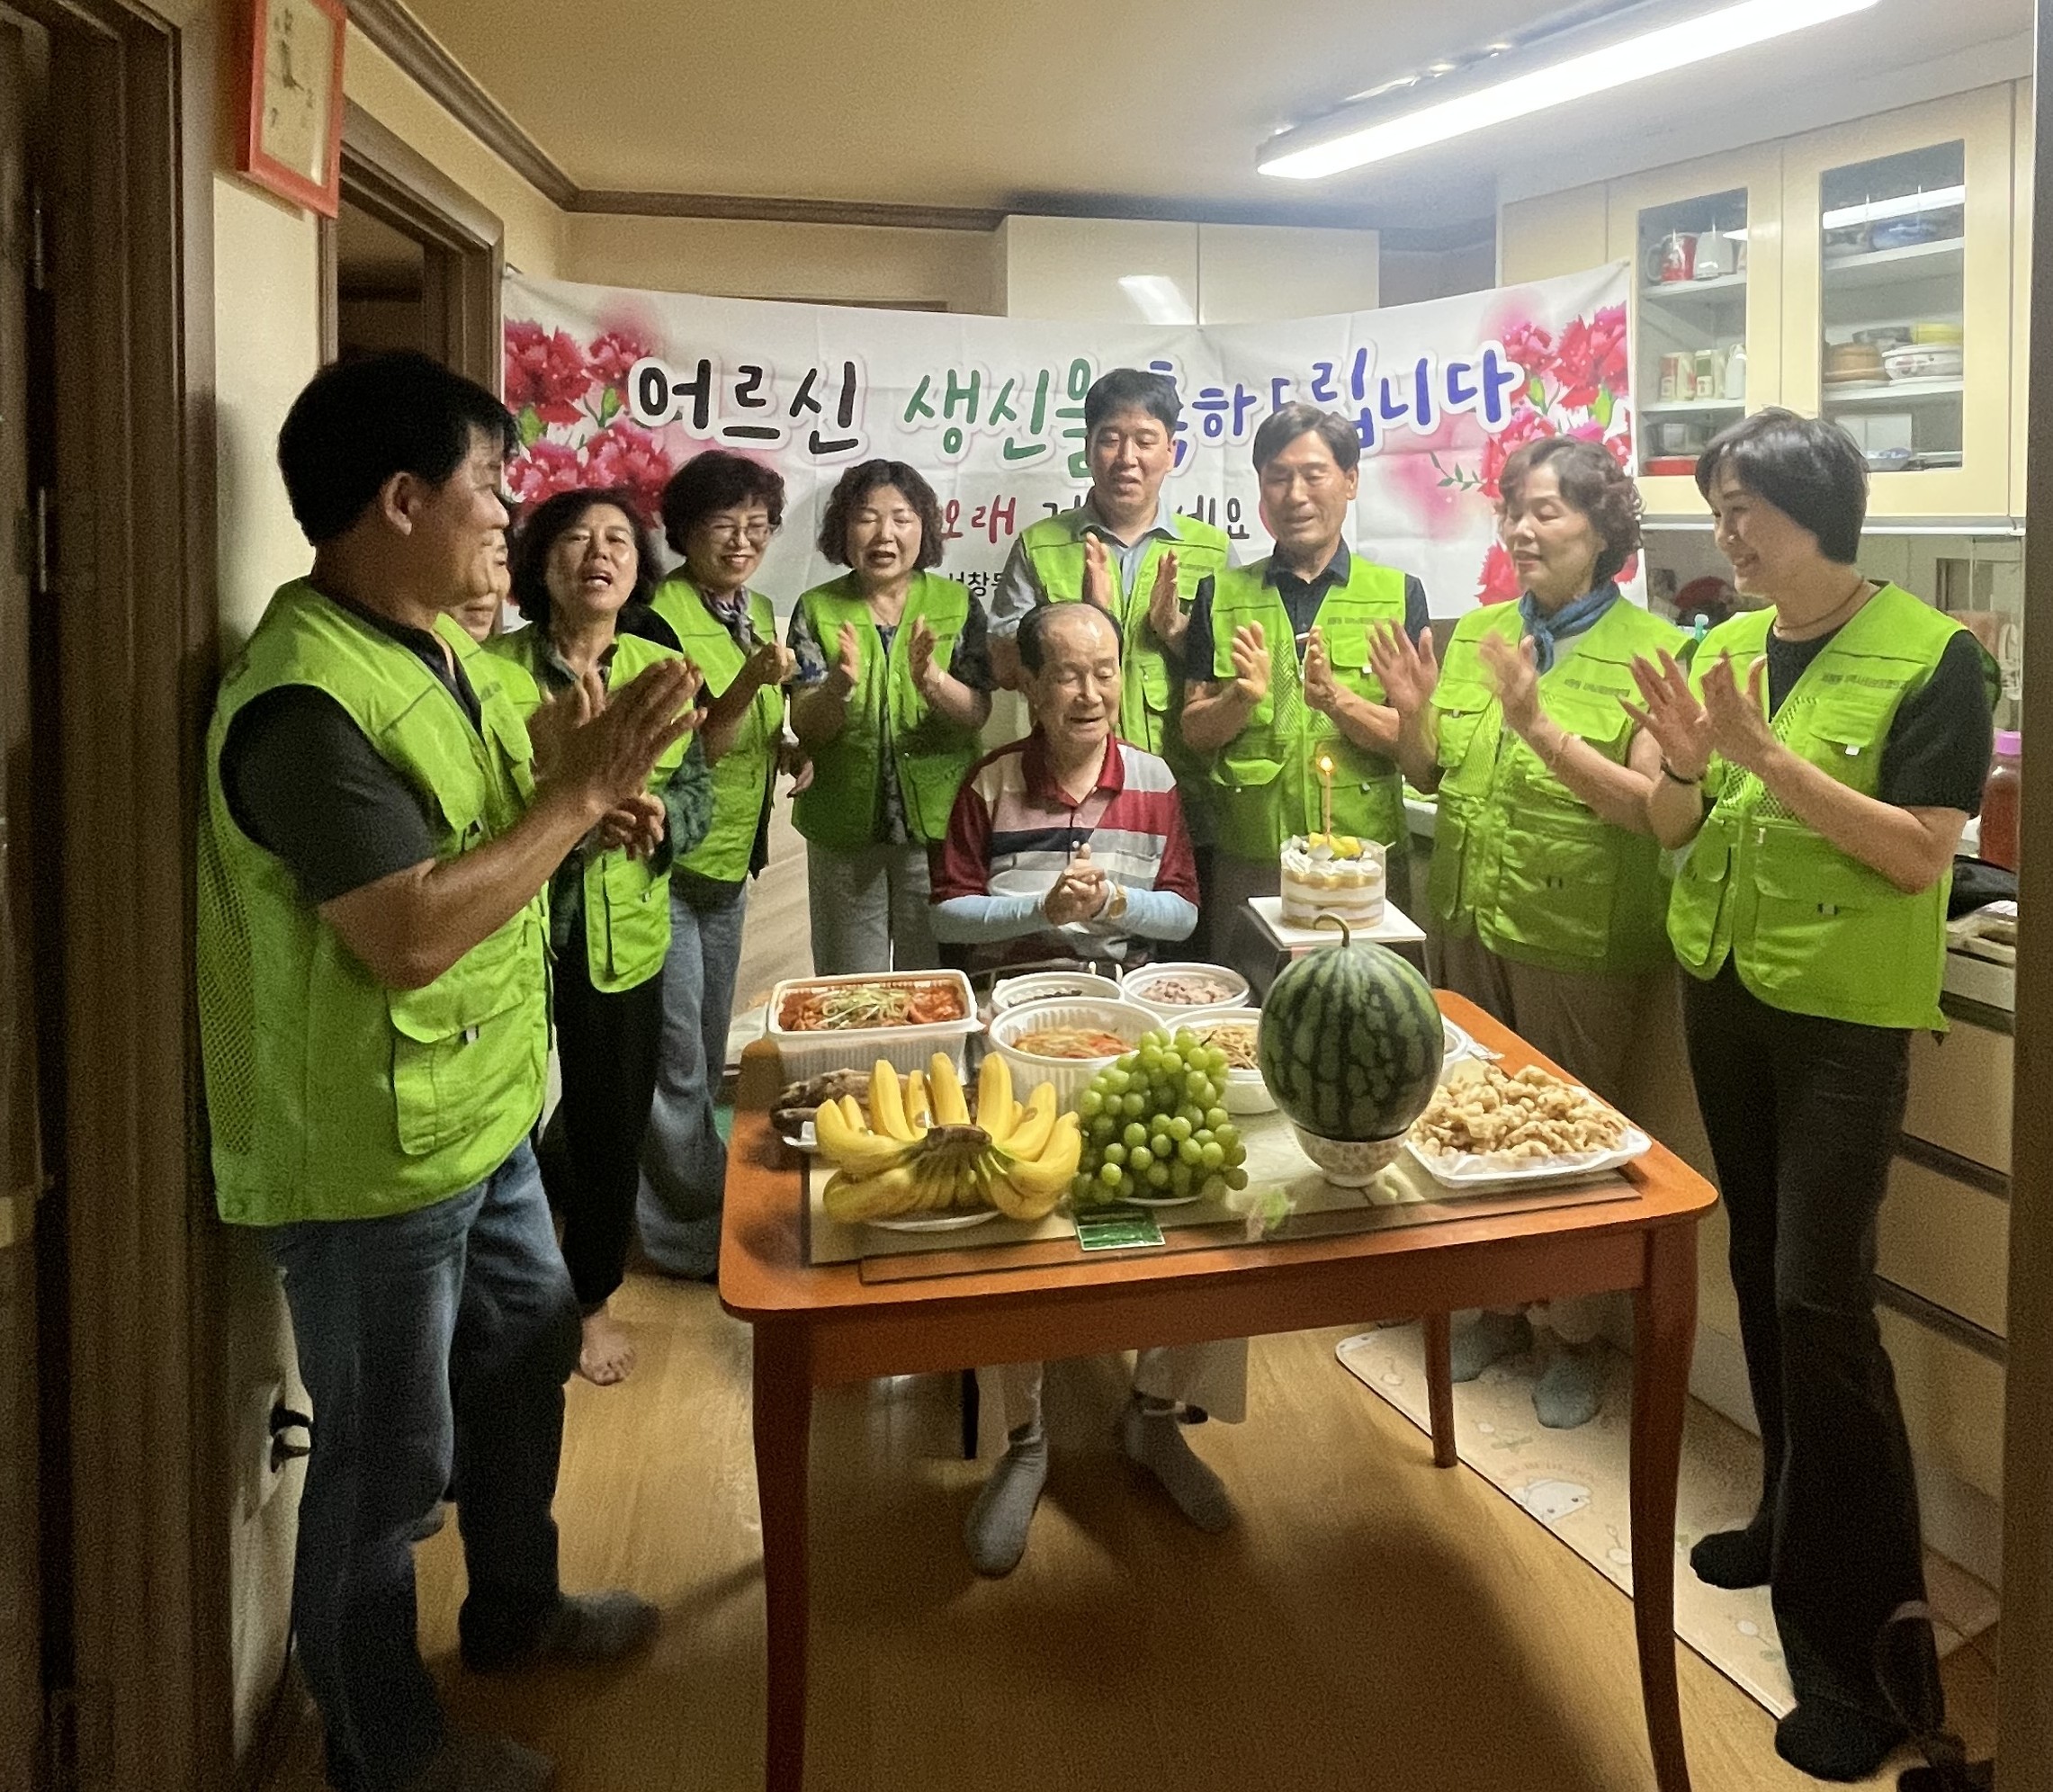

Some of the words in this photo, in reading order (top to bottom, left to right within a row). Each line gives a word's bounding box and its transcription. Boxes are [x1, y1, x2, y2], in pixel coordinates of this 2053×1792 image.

[639, 359, 859, 454] 어르신
[903, 358, 1093, 479] 생신을
[941, 495, 1017, 543] 오래
